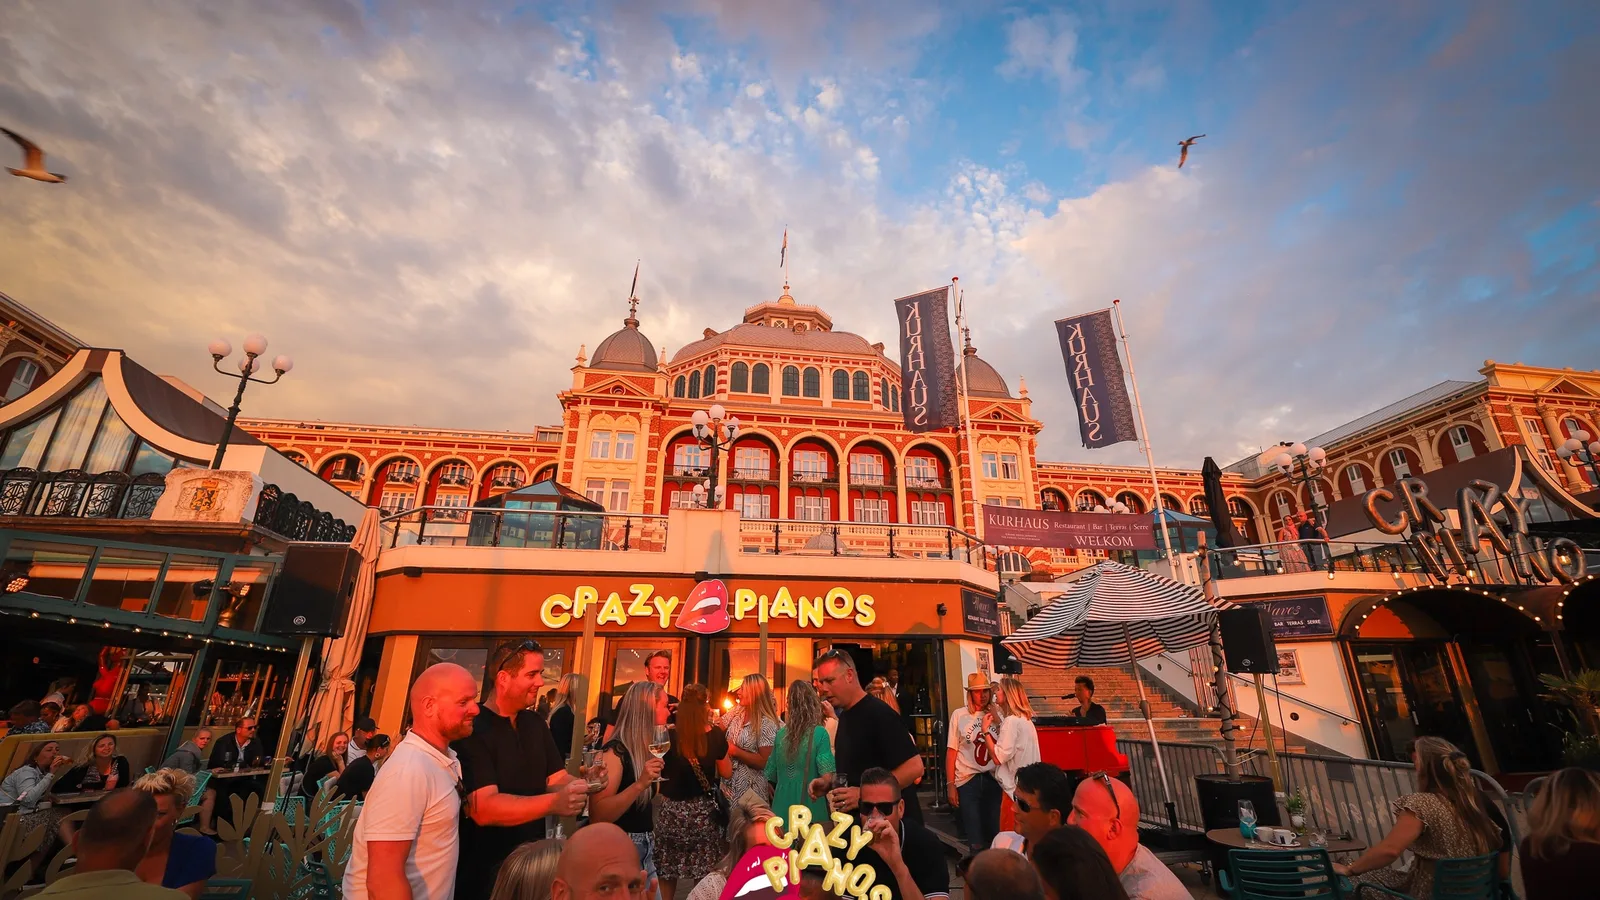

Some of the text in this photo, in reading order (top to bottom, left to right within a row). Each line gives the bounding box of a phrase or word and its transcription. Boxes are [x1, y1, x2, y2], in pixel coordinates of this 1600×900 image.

[989, 513, 1049, 530] KURHAUS
[1054, 521, 1086, 530] Restaurant
[1133, 523, 1149, 531] Serre
[1362, 477, 1532, 556] CRAZY
[1074, 535, 1134, 547] WELKOM
[540, 584, 877, 629] CRAZY PIANOS
